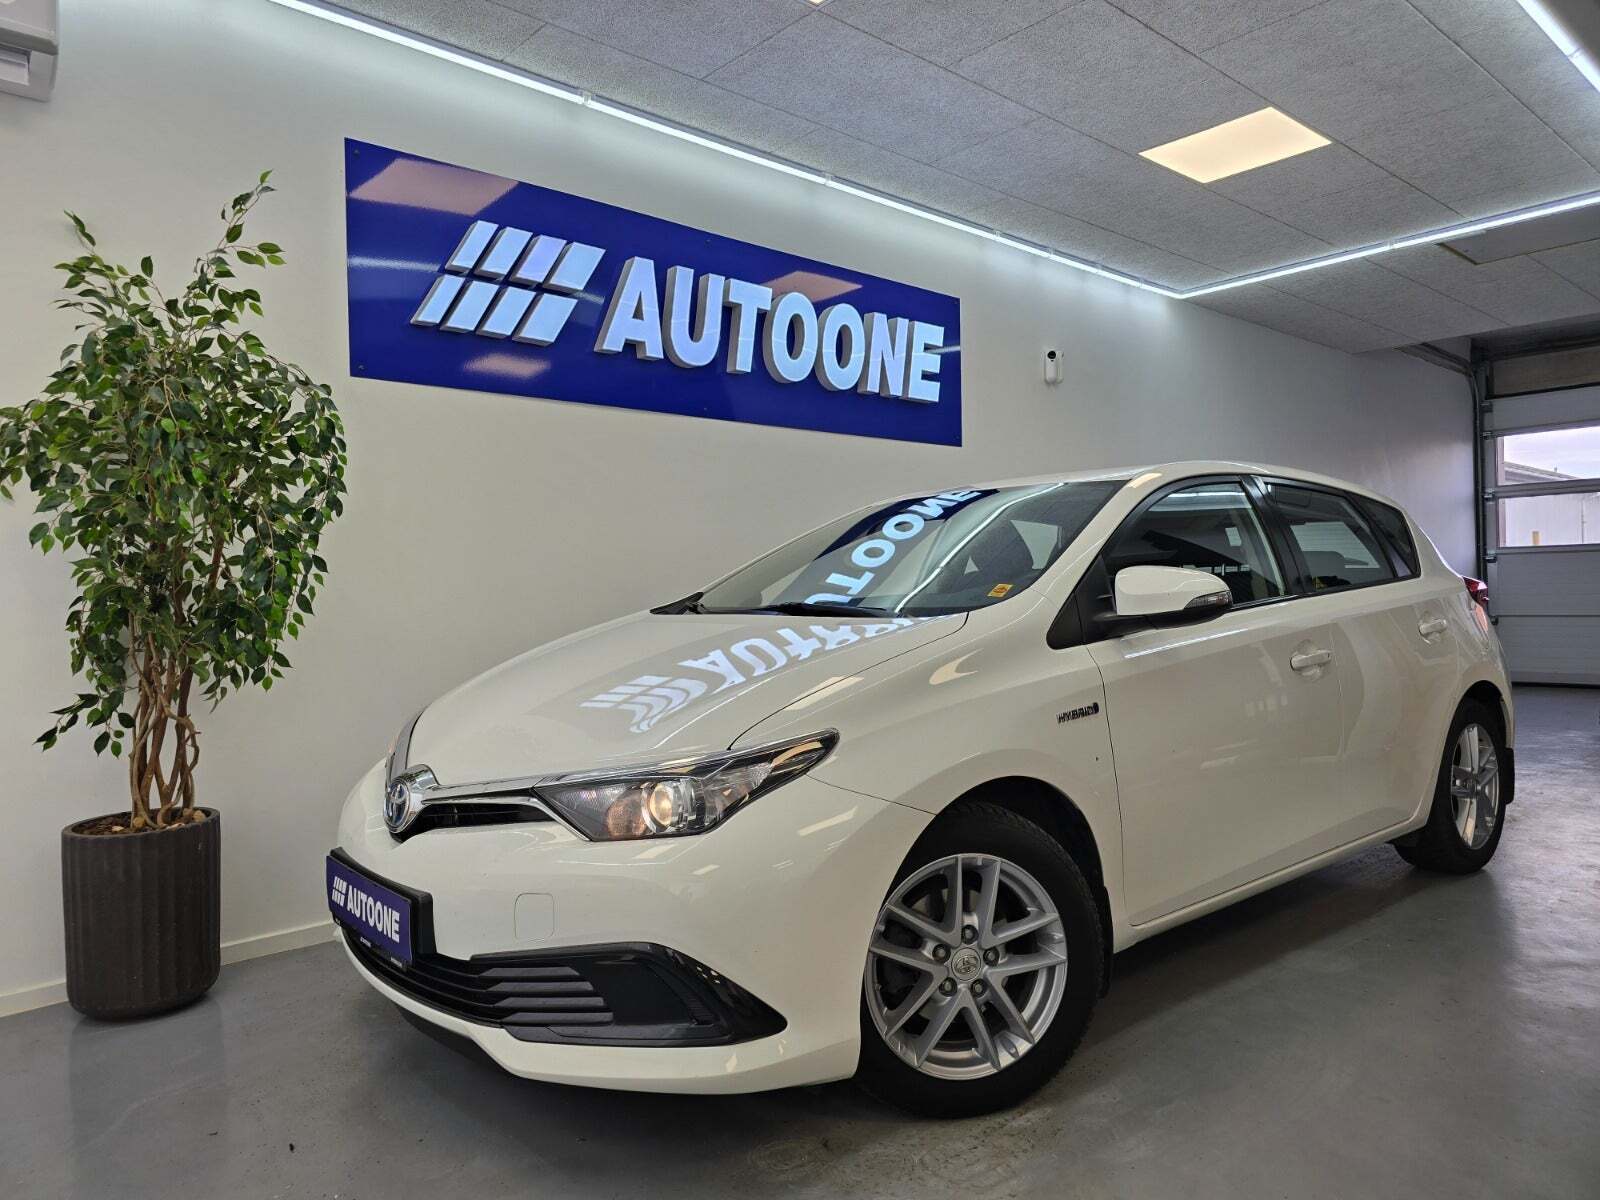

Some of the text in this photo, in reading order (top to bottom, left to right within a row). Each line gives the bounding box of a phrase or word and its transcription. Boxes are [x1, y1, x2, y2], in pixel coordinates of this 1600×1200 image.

[594, 256, 945, 403] AUTOONE
[1056, 704, 1095, 724] HYBRID
[347, 884, 400, 944] AUTOONE
